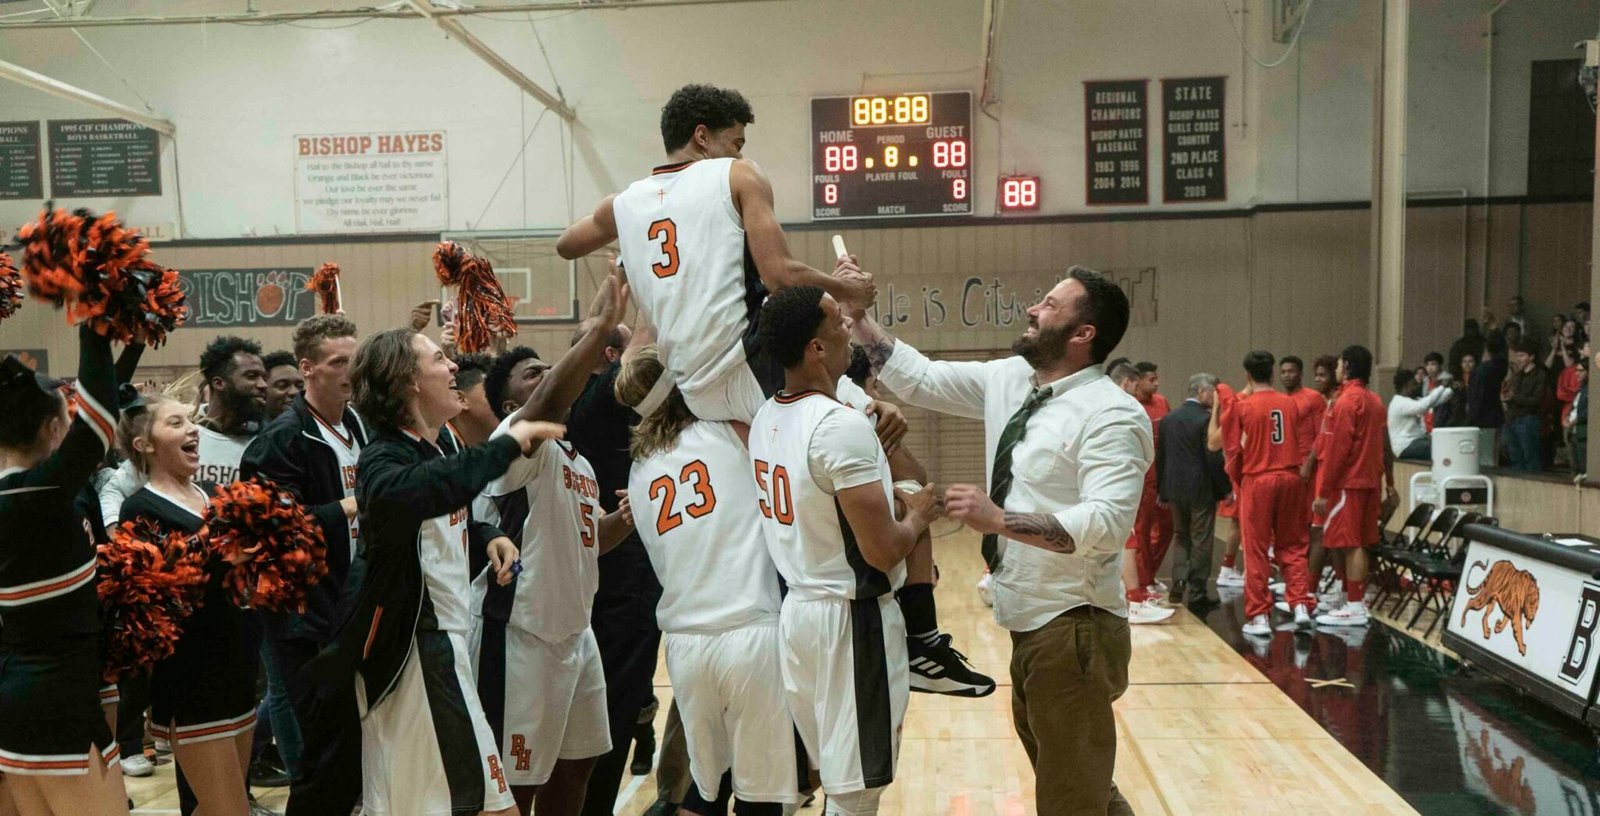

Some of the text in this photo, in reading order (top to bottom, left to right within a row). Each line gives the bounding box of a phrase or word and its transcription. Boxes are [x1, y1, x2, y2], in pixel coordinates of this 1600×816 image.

[1095, 91, 1137, 104] REGIONAL
[1175, 86, 1212, 101] STATE
[854, 96, 928, 125] 88:88
[1091, 108, 1142, 121] CHAMPIONS
[1168, 109, 1220, 121] BISHOP HAYES
[926, 126, 964, 139] GUEST
[1091, 128, 1143, 141] BISHOP HAYES
[1168, 122, 1219, 133] GIRLS CROSS
[820, 130, 854, 143] HOME
[876, 134, 905, 144] PERIOD
[1177, 134, 1210, 146] COUNTRY
[298, 133, 443, 156] BISHOP HAYES
[1096, 141, 1138, 153] BASEBALL
[825, 145, 858, 171] 88
[884, 146, 899, 167] 8
[933, 141, 966, 168] 88
[1171, 150, 1219, 165] 2ND PLACE
[815, 174, 840, 184] FOULS
[865, 171, 919, 182] PLAYER FOUL
[941, 170, 968, 179] FOULS
[1176, 167, 1214, 180] CLASS 4
[825, 184, 838, 204] 8
[953, 179, 966, 199] 8
[1004, 180, 1036, 206] 88
[815, 207, 841, 217] SCORE
[877, 205, 906, 214] MATCH
[942, 203, 969, 212] SCORE
[648, 217, 680, 279] 3
[873, 284, 912, 328] ide
[922, 287, 947, 328] is
[1270, 409, 1285, 444] 3
[649, 459, 716, 536] 23
[754, 459, 794, 526] 50
[580, 503, 595, 548] 5
[510, 734, 532, 771] BH
